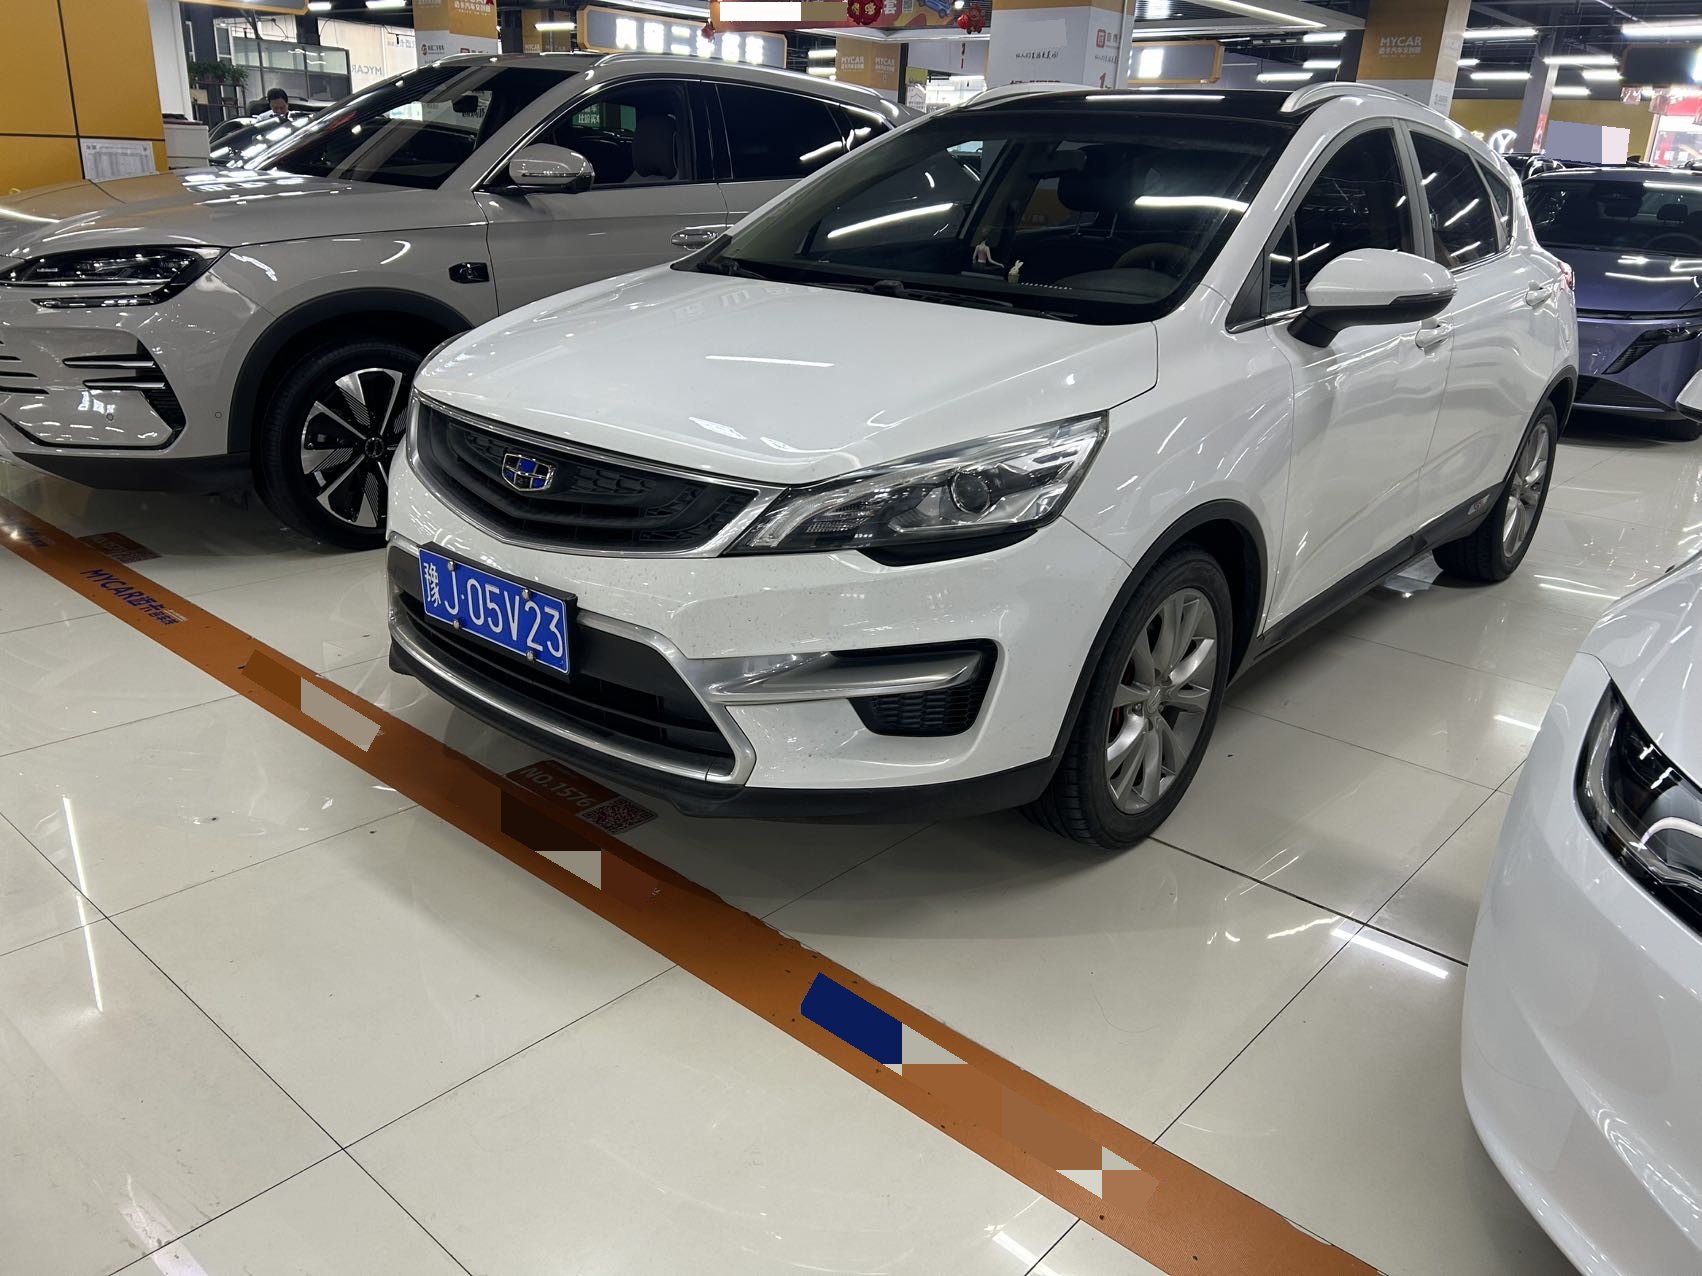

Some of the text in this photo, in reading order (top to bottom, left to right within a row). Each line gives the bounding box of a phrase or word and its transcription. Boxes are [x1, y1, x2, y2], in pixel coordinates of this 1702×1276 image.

[1380, 36, 1422, 46] MYCAR
[841, 56, 865, 64] MYCAR
[518, 767, 594, 807] NO.1576
